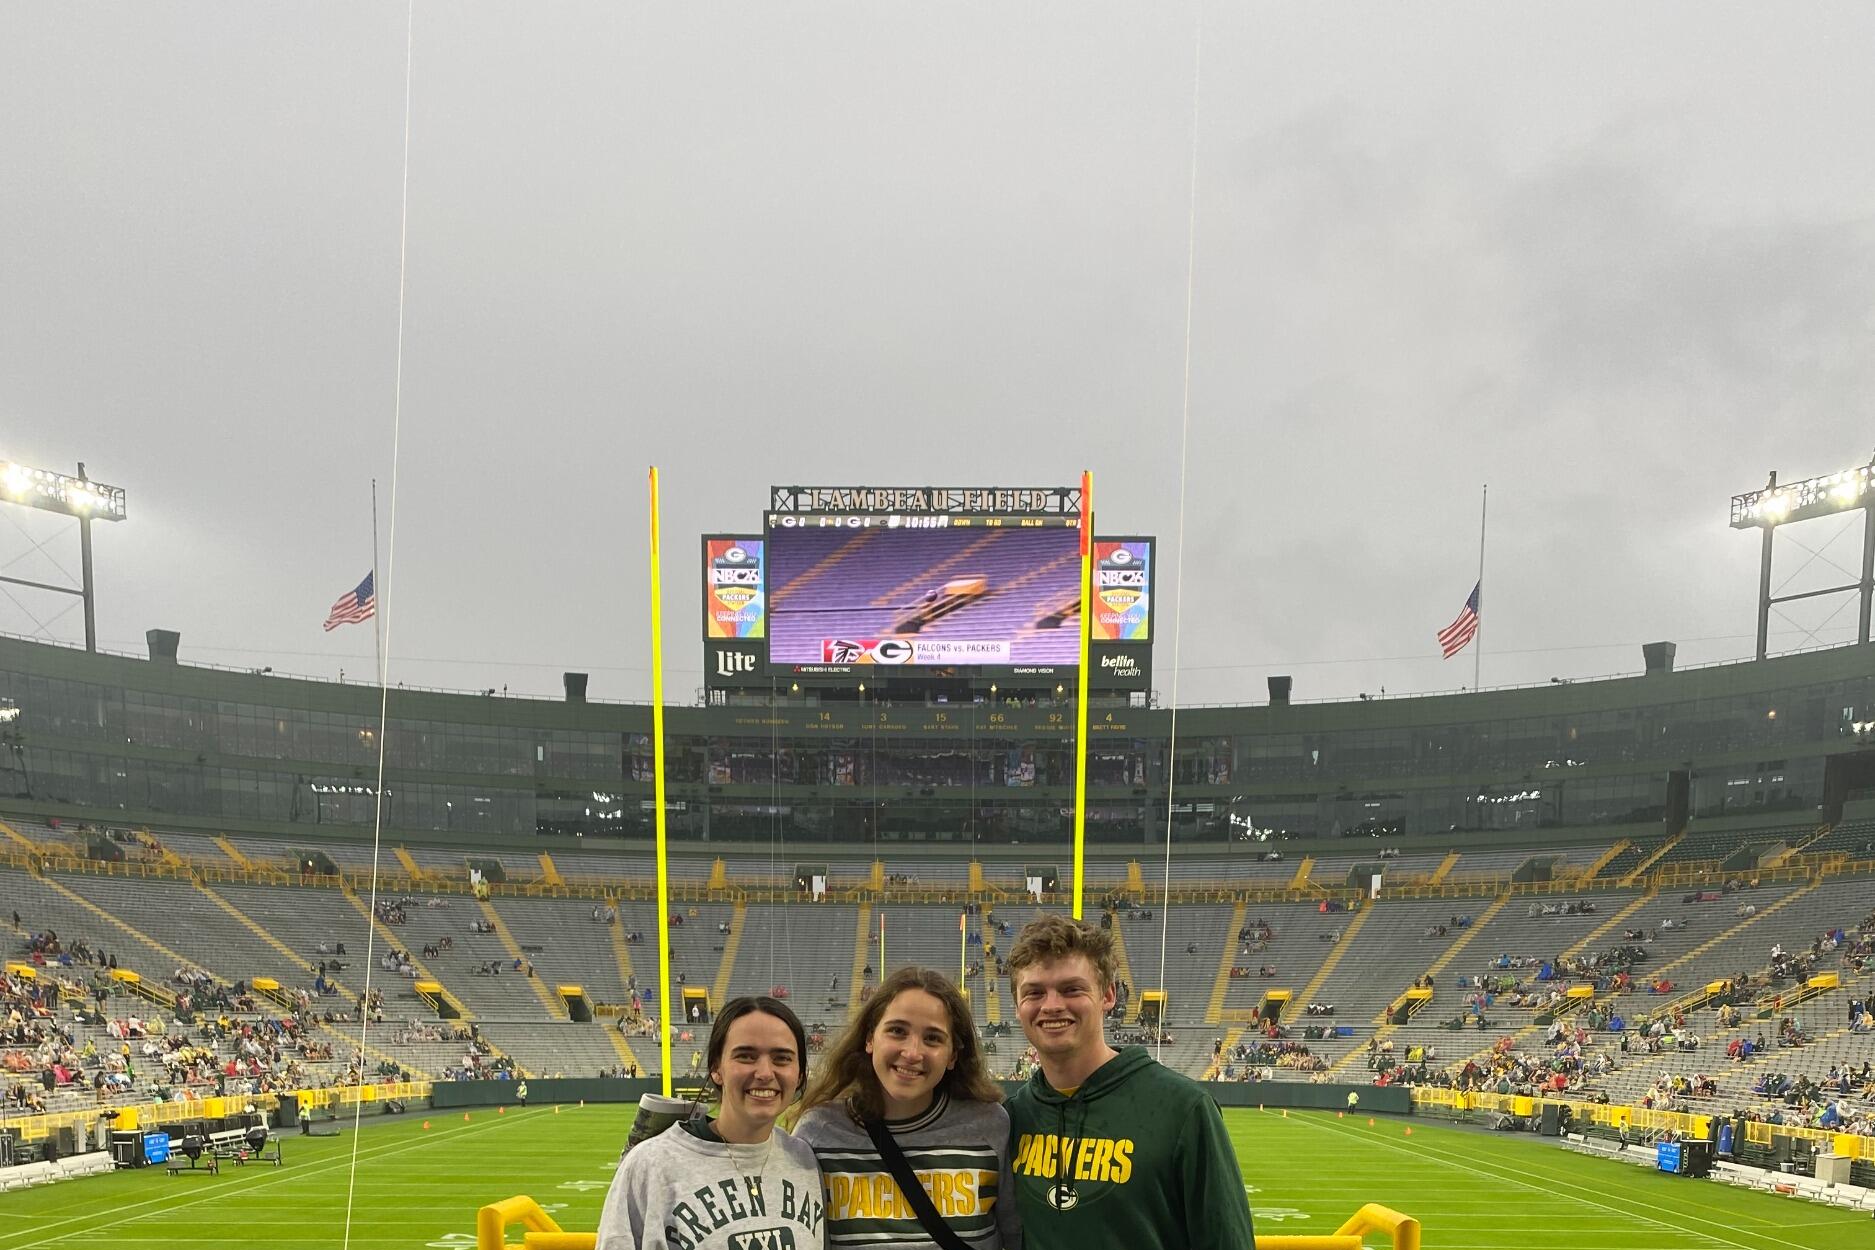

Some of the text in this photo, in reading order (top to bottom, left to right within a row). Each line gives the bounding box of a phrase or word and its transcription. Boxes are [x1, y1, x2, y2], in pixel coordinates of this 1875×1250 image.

[810, 488, 1049, 510] LAMBEAU FIELD
[917, 643, 951, 652] FALCONS
[966, 643, 1001, 653] PACKERS
[716, 650, 756, 677] Lite
[1101, 655, 1135, 668] bellin
[1113, 666, 1141, 677] health
[819, 712, 831, 721] 14
[880, 712, 888, 722] 3
[935, 713, 947, 722] 15
[990, 713, 1004, 722] 66
[1049, 713, 1063, 722] 92
[1105, 712, 1113, 722] 4
